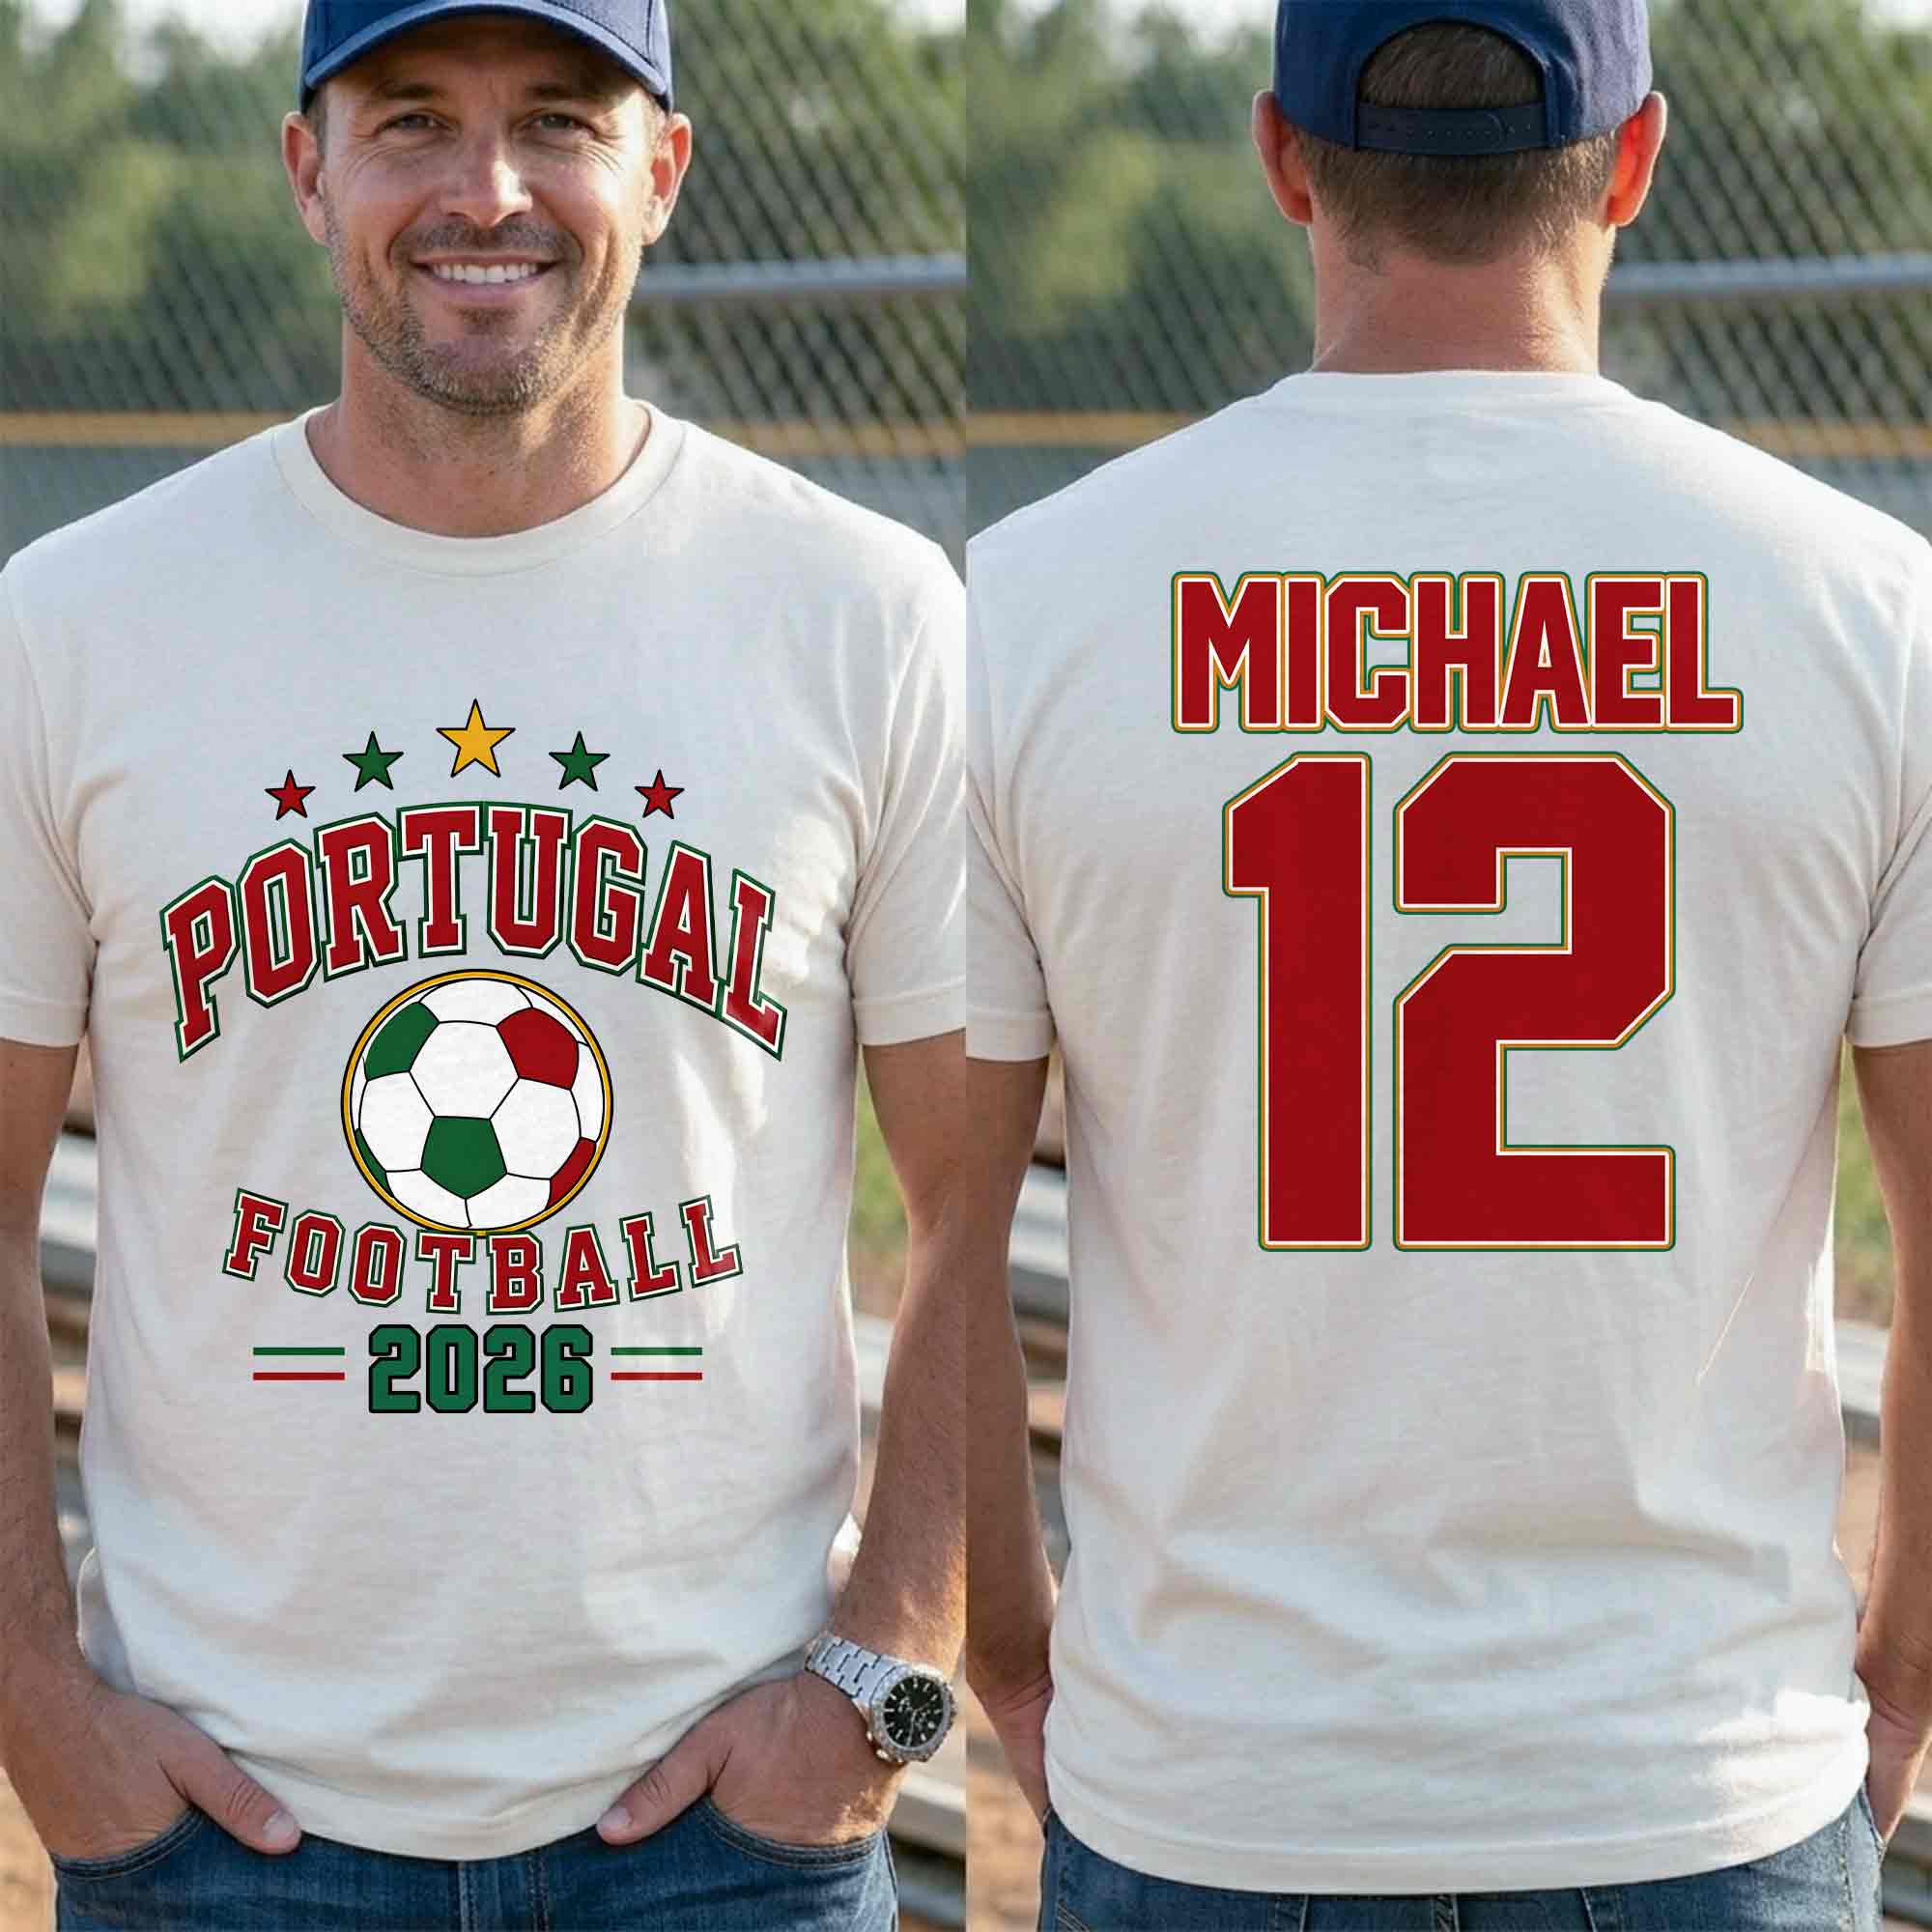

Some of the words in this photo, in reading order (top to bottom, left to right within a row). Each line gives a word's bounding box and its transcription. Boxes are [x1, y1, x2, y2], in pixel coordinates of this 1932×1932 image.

[1171, 571, 1744, 734] MICHAEL
[159, 801, 788, 1063] PORTUGAL
[1222, 752, 1676, 1252] 12
[222, 1187, 743, 1316] FOOTBALL
[368, 1324, 594, 1413] 2026
